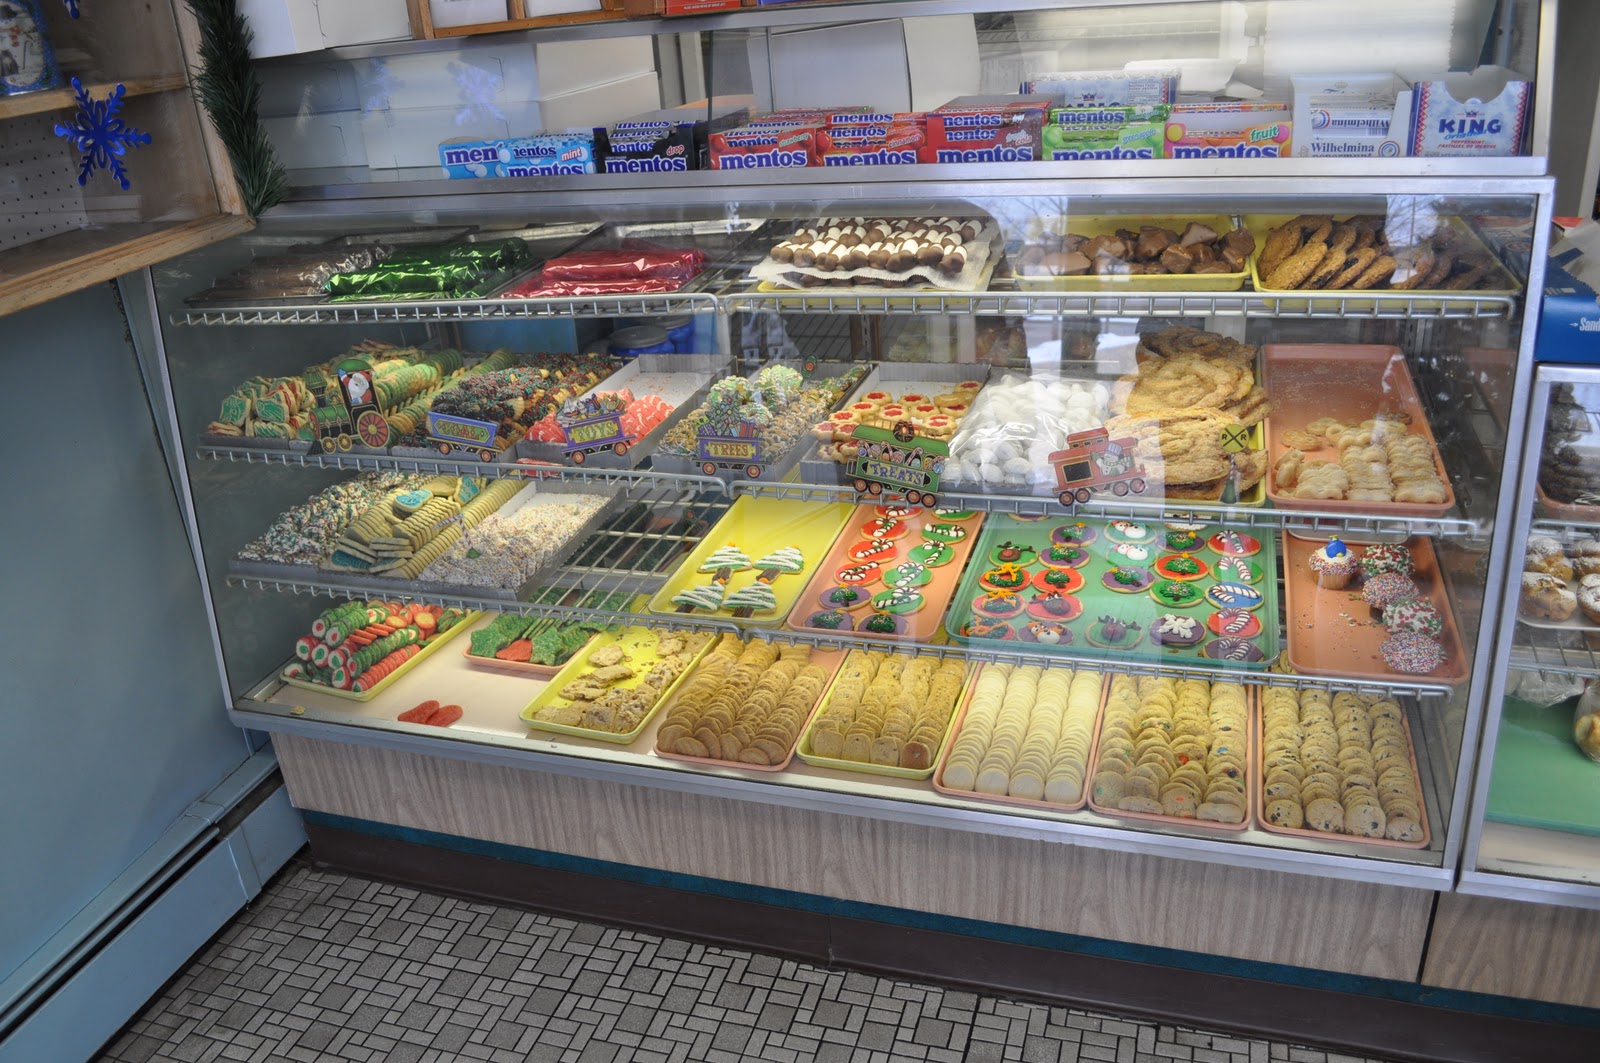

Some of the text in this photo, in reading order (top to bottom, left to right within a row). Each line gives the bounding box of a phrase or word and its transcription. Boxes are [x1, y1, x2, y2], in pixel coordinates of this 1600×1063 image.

[831, 113, 894, 123] mentos
[1057, 110, 1126, 123] mentos
[1250, 124, 1280, 143] fruit
[1439, 119, 1502, 134] KING
[888, 133, 922, 148] cinnamon
[1014, 135, 1033, 146] cola
[1311, 142, 1375, 153] Wilhelmina
[444, 143, 503, 165] men
[561, 147, 583, 162] mint
[665, 144, 685, 156] drop
[823, 148, 917, 167] mentos
[936, 144, 1034, 163] mentos
[1052, 145, 1154, 160] mentos
[1172, 142, 1280, 158] mentos
[605, 155, 687, 173] mentos
[719, 148, 808, 170] mentos
[506, 161, 585, 177] mentos
[442, 421, 480, 440] COAL
[574, 421, 617, 442] TOYS
[711, 443, 749, 458] TREES
[869, 462, 925, 487] TREATS
